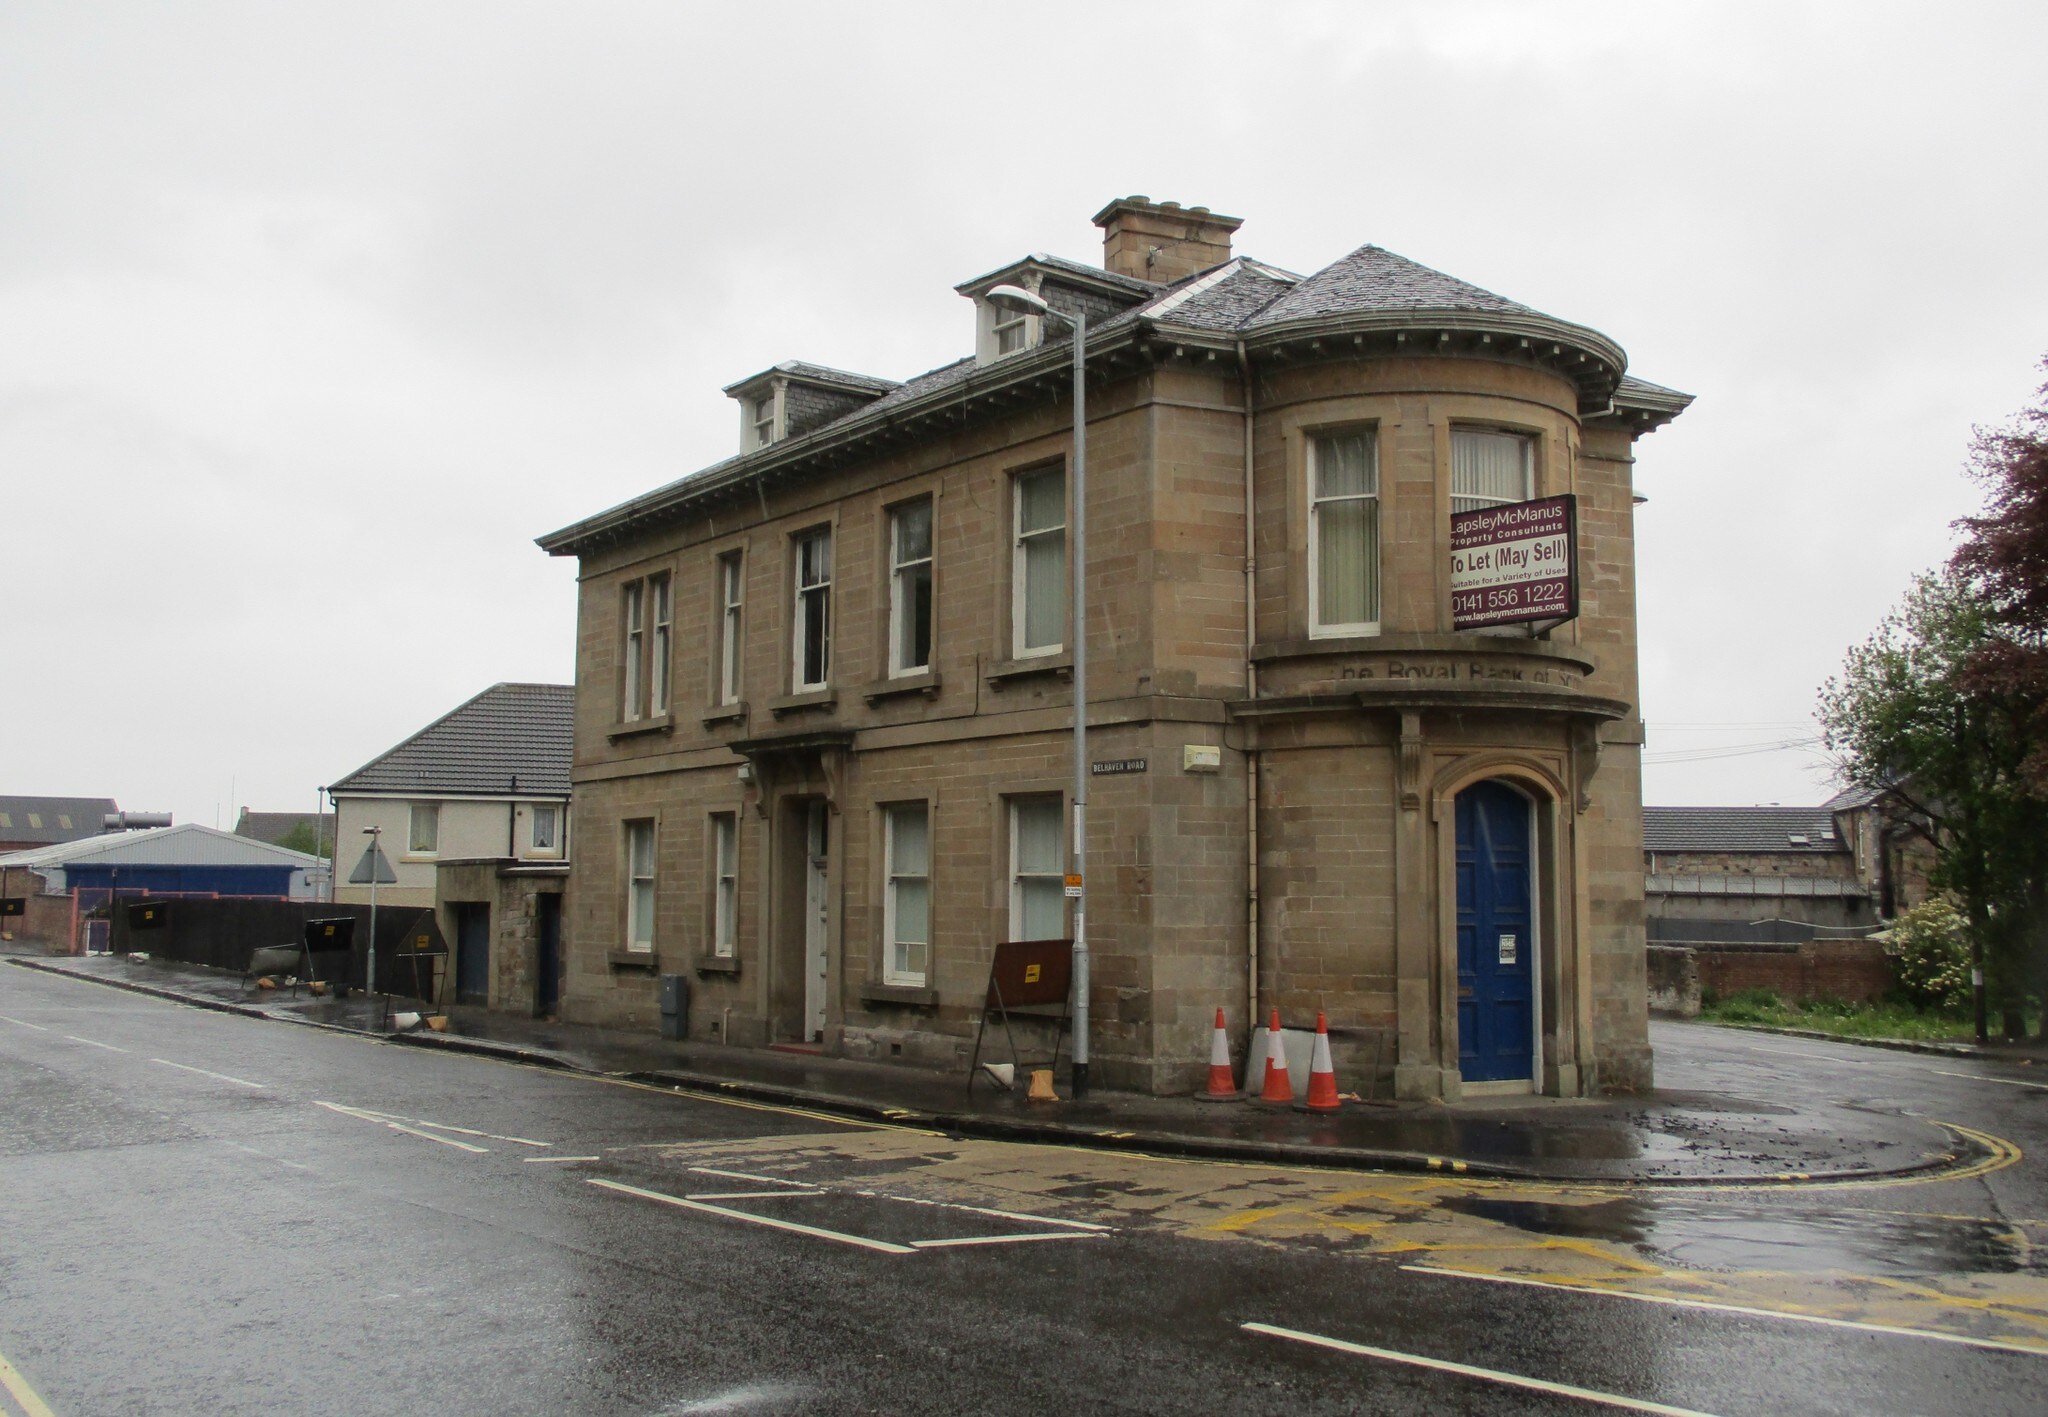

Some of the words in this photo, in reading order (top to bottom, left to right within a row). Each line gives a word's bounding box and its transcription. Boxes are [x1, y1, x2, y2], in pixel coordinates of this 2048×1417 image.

[1450, 505, 1562, 535] apsleyMcManus
[1497, 522, 1563, 539] Consultants
[1468, 551, 1490, 571] Let
[1495, 545, 1529, 572] (May
[1533, 538, 1567, 563] Sell)
[1482, 576, 1493, 584] for
[1502, 570, 1532, 582] Variety
[1534, 568, 1543, 577] of
[1545, 566, 1567, 576] Uses
[1452, 592, 1483, 613] 0141
[1488, 588, 1518, 608] 556
[1524, 581, 1565, 603] 1222
[1093, 762, 1124, 773] BELHAVEN
[1126, 760, 1145, 770] ROAD
